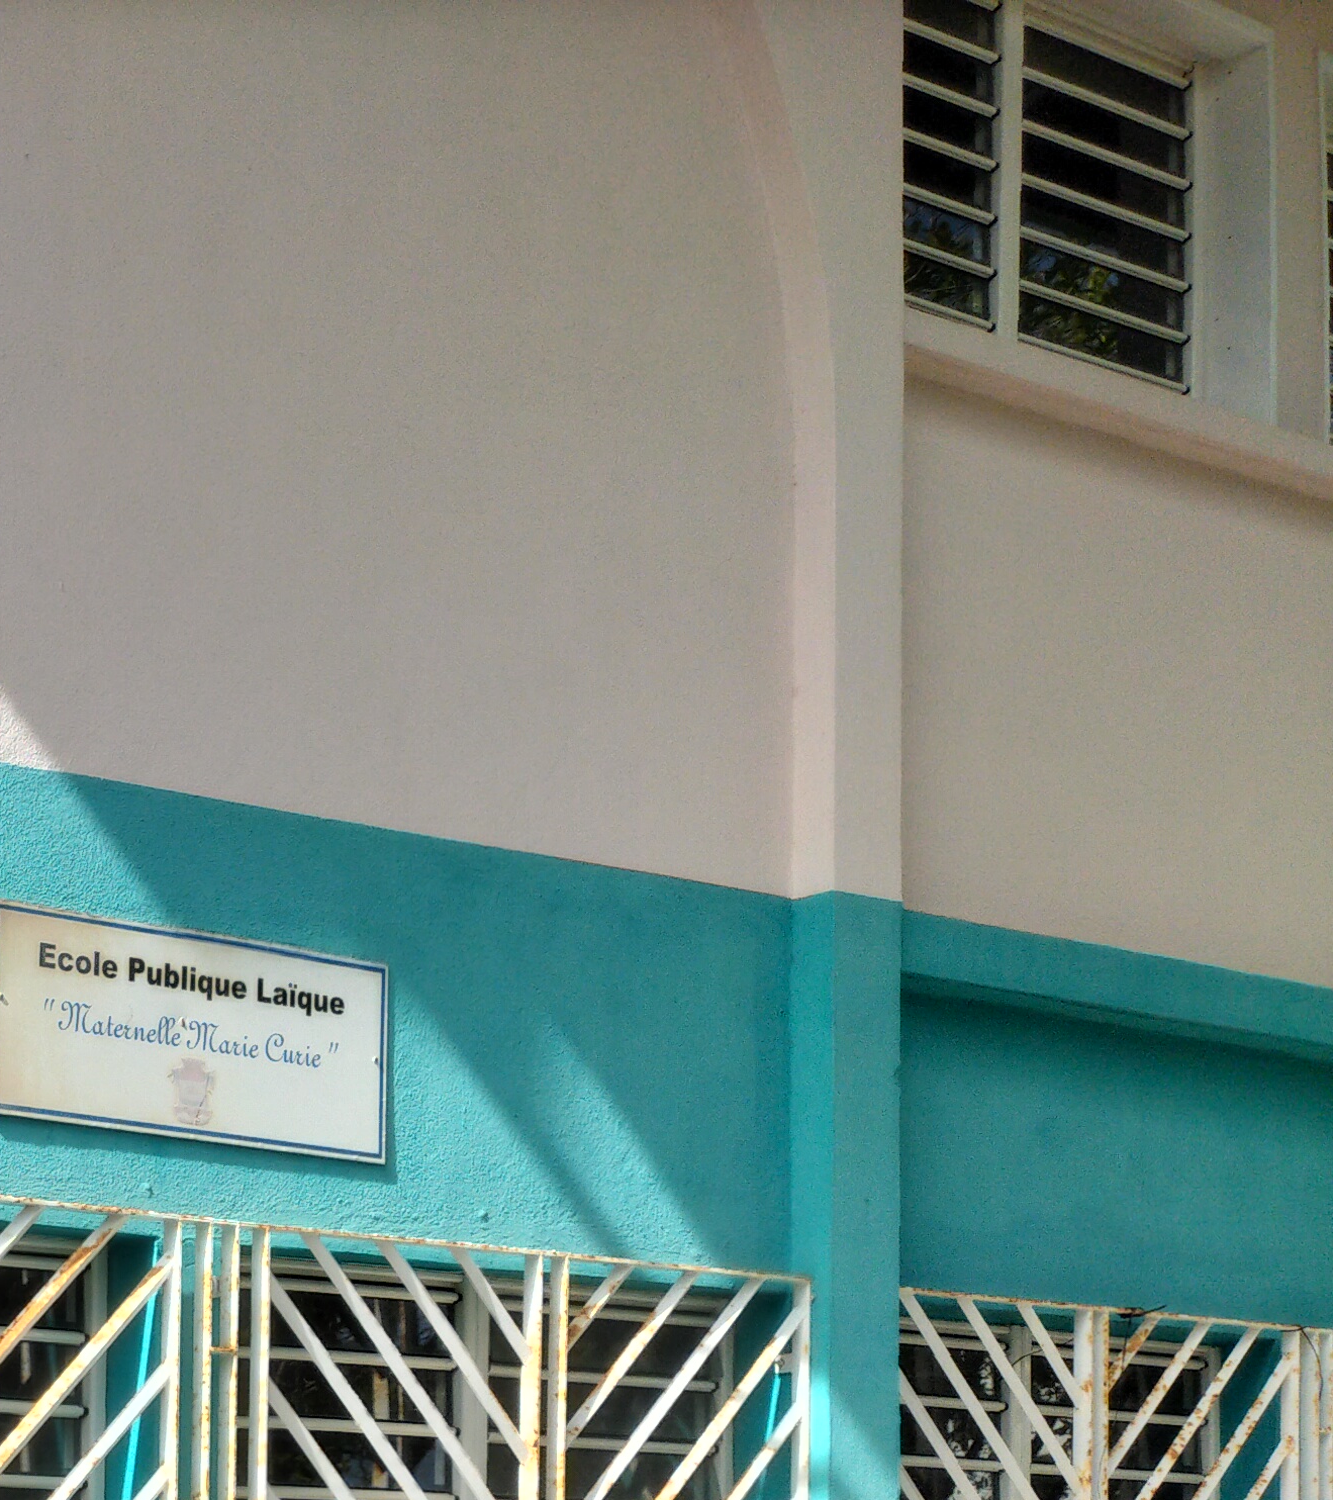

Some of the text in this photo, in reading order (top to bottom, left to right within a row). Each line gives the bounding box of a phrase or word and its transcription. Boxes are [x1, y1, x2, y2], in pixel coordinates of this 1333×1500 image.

[38, 941, 346, 1017] Ecole Publique Laïque
[186, 1020, 259, 1060] Marie
